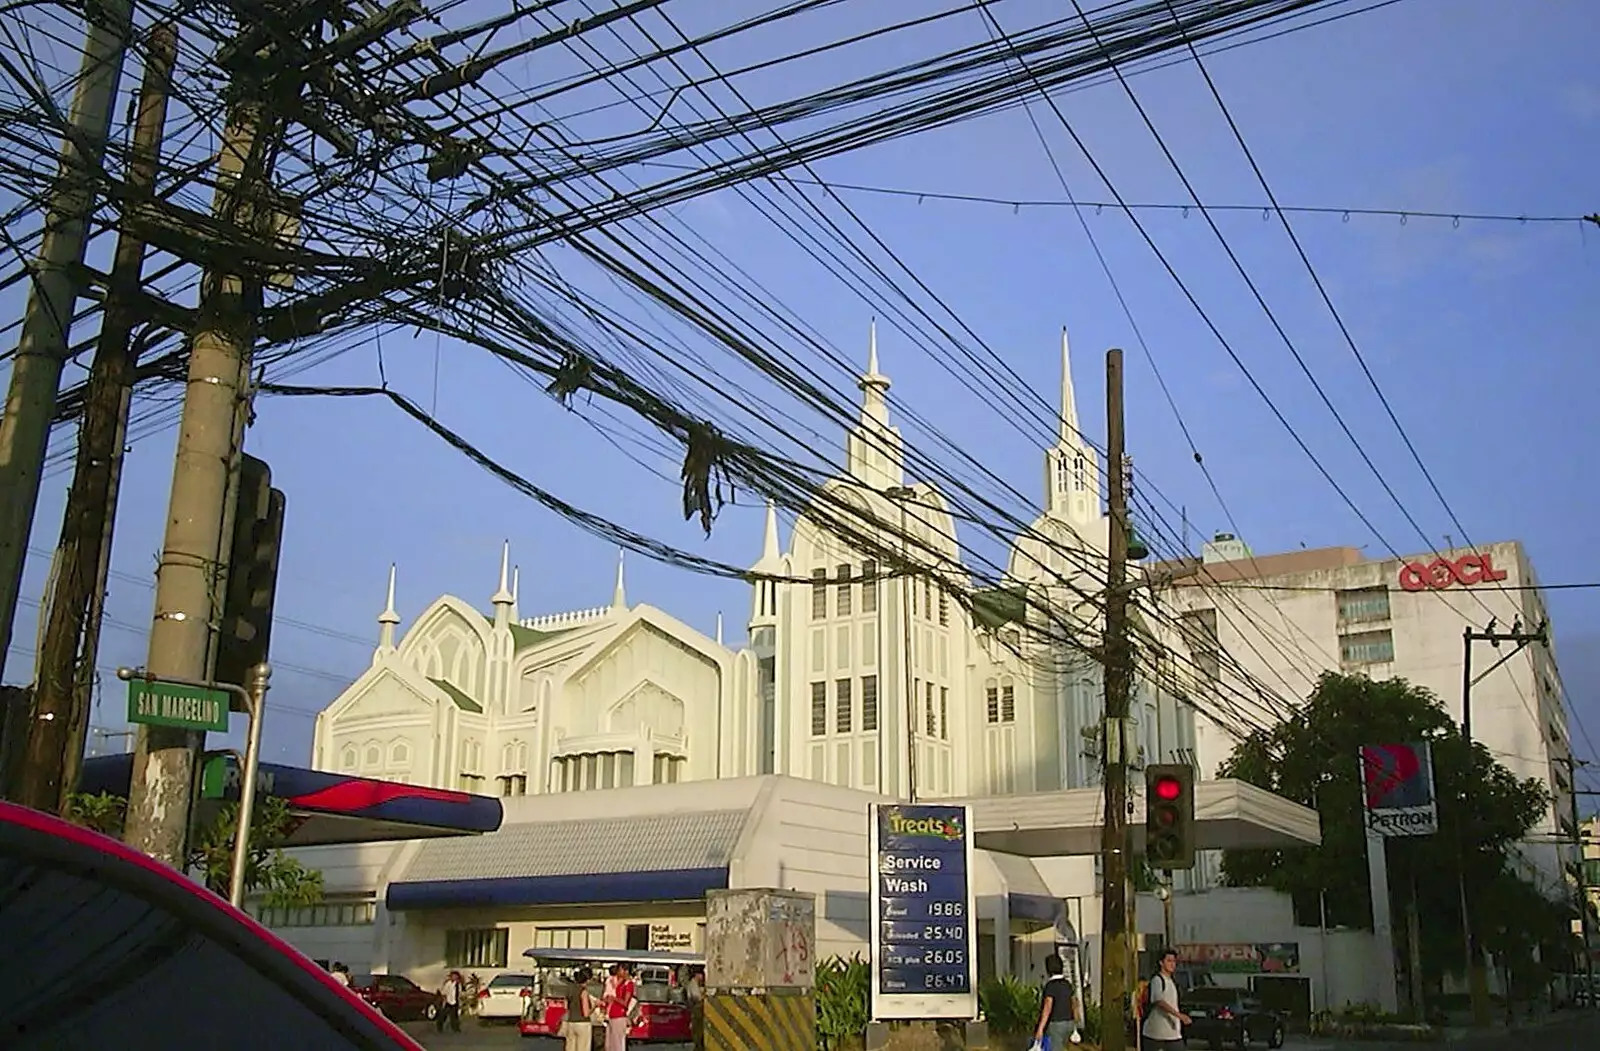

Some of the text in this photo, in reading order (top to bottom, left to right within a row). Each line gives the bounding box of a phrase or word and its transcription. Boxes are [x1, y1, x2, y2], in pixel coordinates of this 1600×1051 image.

[138, 692, 220, 724] SAN MARCELINO
[888, 814, 945, 834] Treats
[1368, 811, 1433, 828] PETRON
[886, 854, 942, 869] Service
[885, 877, 928, 893] Wash
[927, 902, 963, 917] 19.86
[923, 926, 964, 941] 25.40
[924, 950, 964, 964] 26.05
[924, 974, 965, 988] 26.47
